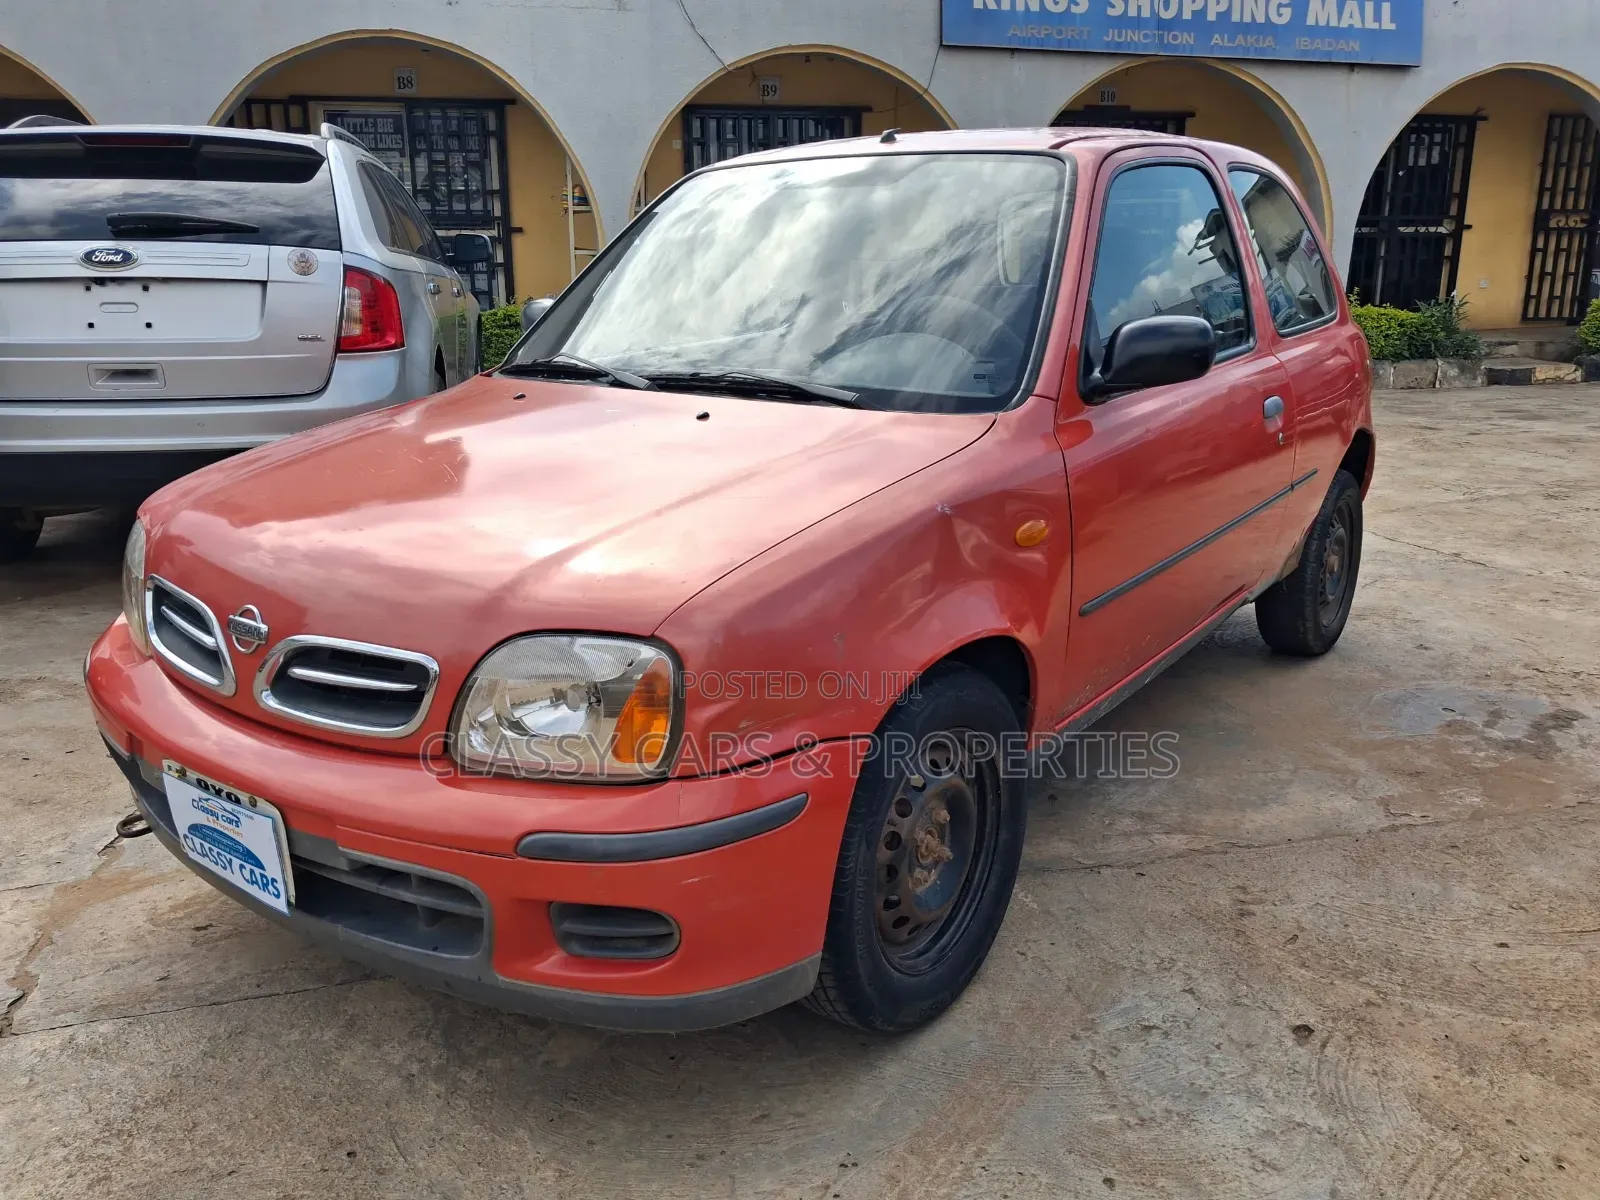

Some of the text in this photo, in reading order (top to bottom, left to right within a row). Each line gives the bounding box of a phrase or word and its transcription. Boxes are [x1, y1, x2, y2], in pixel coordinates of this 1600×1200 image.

[1106, 0, 1293, 25] SHOPPING
[1306, 0, 1397, 30] MALL
[1007, 25, 1091, 40] AIRPORT
[1103, 28, 1195, 45] JUNCTION
[1295, 37, 1361, 52] IBADAN
[396, 75, 414, 90] B8
[761, 84, 778, 97] B9
[1099, 90, 1116, 103] B10
[377, 117, 394, 133] BIG
[377, 134, 403, 149] LINES
[91, 250, 123, 262] Ford
[230, 619, 262, 639] NISSAN
[195, 777, 242, 805] OYO
[191, 798, 219, 821] Classy
[220, 814, 240, 828] cars
[212, 818, 243, 838] Properties
[182, 833, 235, 875] CLASSY
[238, 863, 281, 900] CARS
